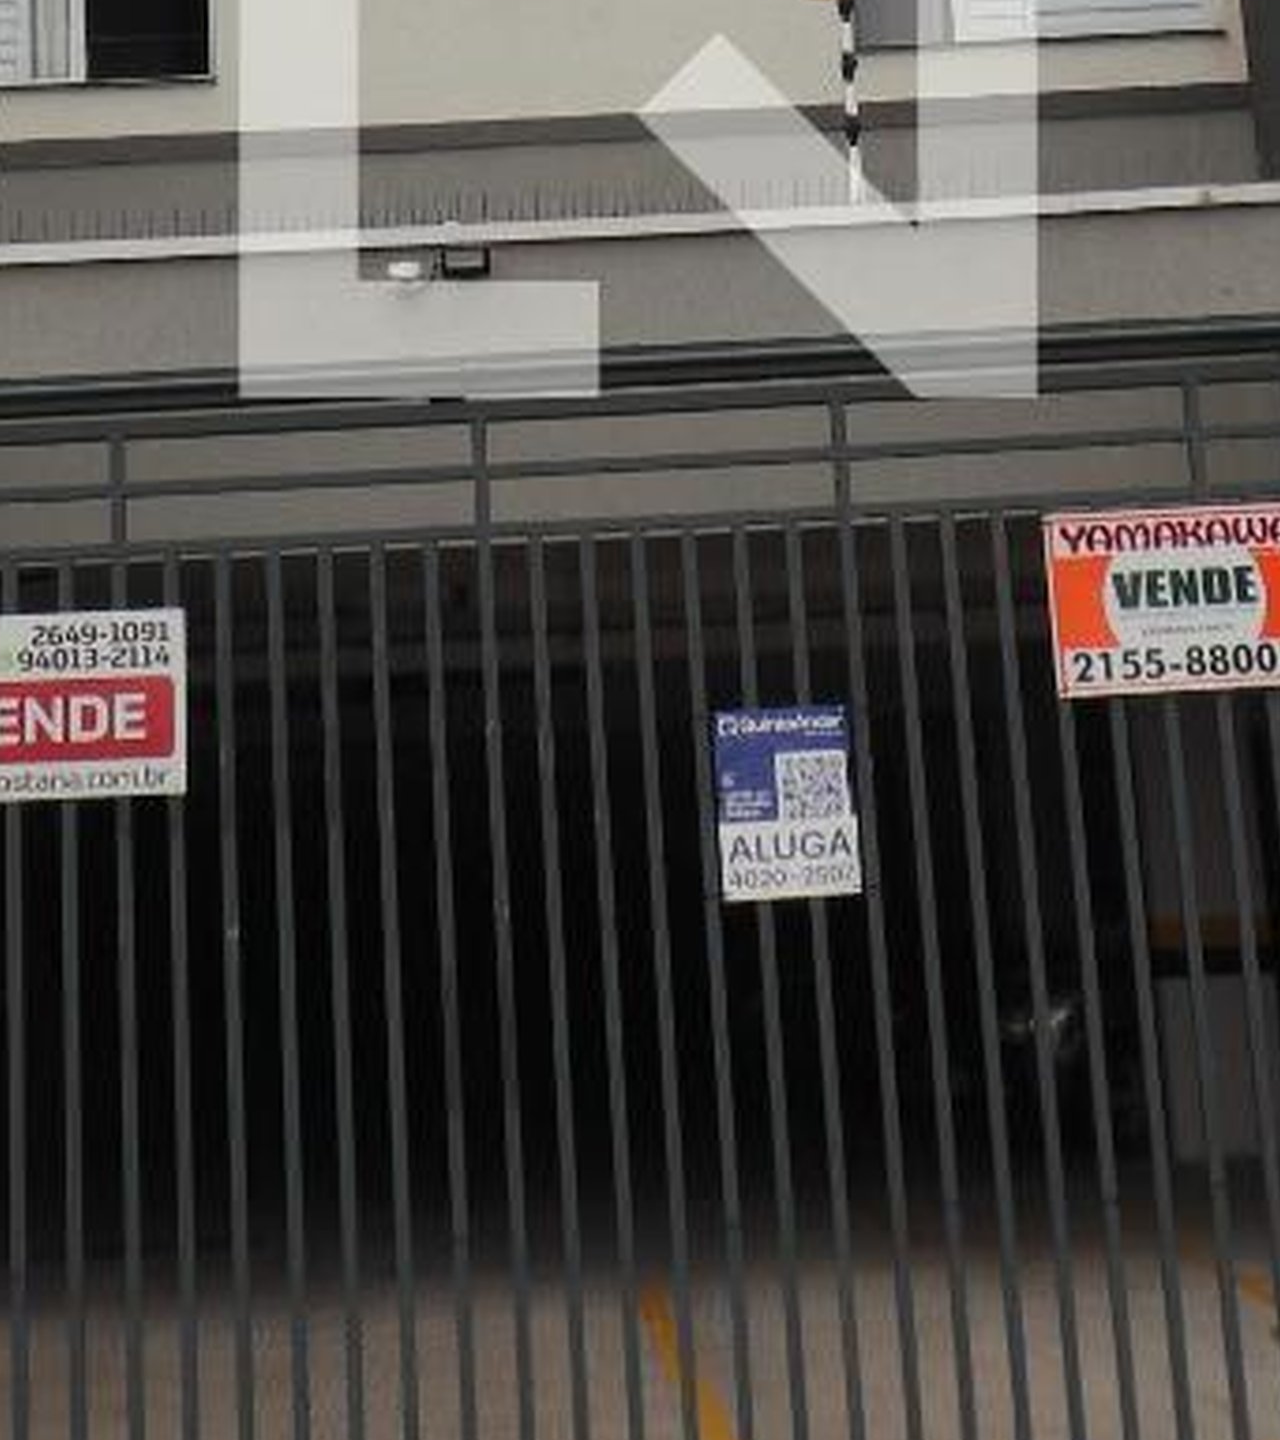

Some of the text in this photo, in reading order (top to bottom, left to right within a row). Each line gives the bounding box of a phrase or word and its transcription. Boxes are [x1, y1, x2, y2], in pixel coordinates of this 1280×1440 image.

[1111, 565, 1260, 609] VENDE
[31, 621, 170, 647] 2649-1091
[16, 645, 170, 672] 94013-2114
[1072, 643, 1278, 683] 2155-8800
[729, 827, 852, 864] ALUGA
